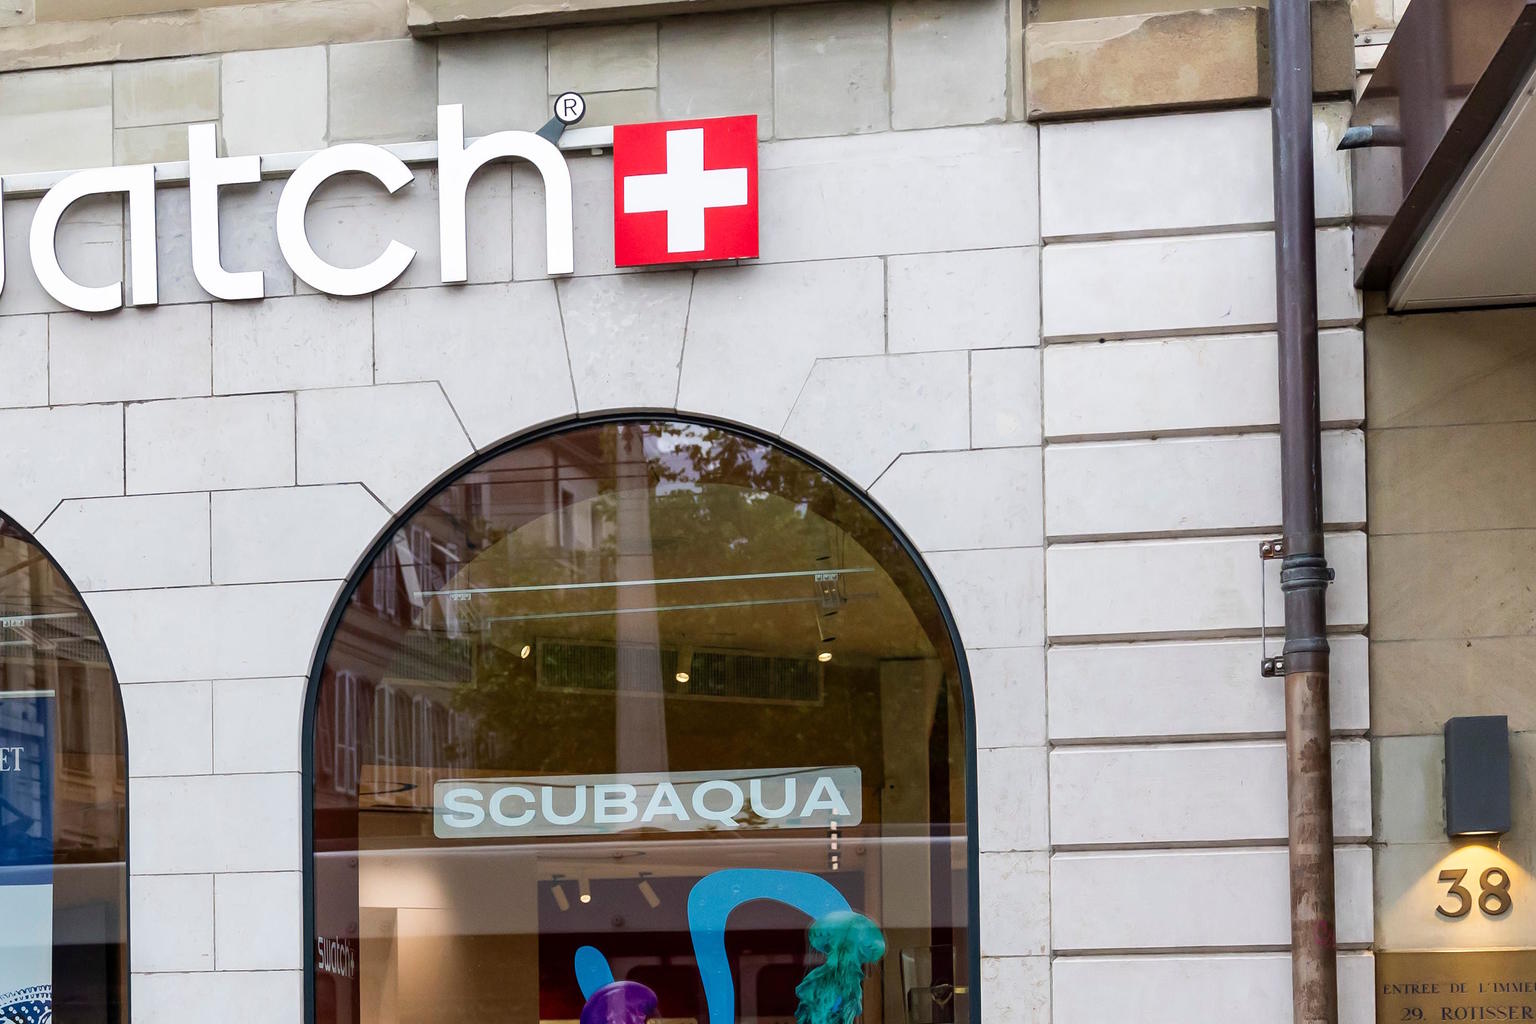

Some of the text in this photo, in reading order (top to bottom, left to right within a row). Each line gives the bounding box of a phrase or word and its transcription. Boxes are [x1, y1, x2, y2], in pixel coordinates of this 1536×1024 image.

[441, 774, 851, 829] SCUBAQUA
[1435, 866, 1513, 919] 38
[1383, 981, 1536, 994] ENTREE DE L'IMME
[1400, 1006, 1427, 1021] 29.
